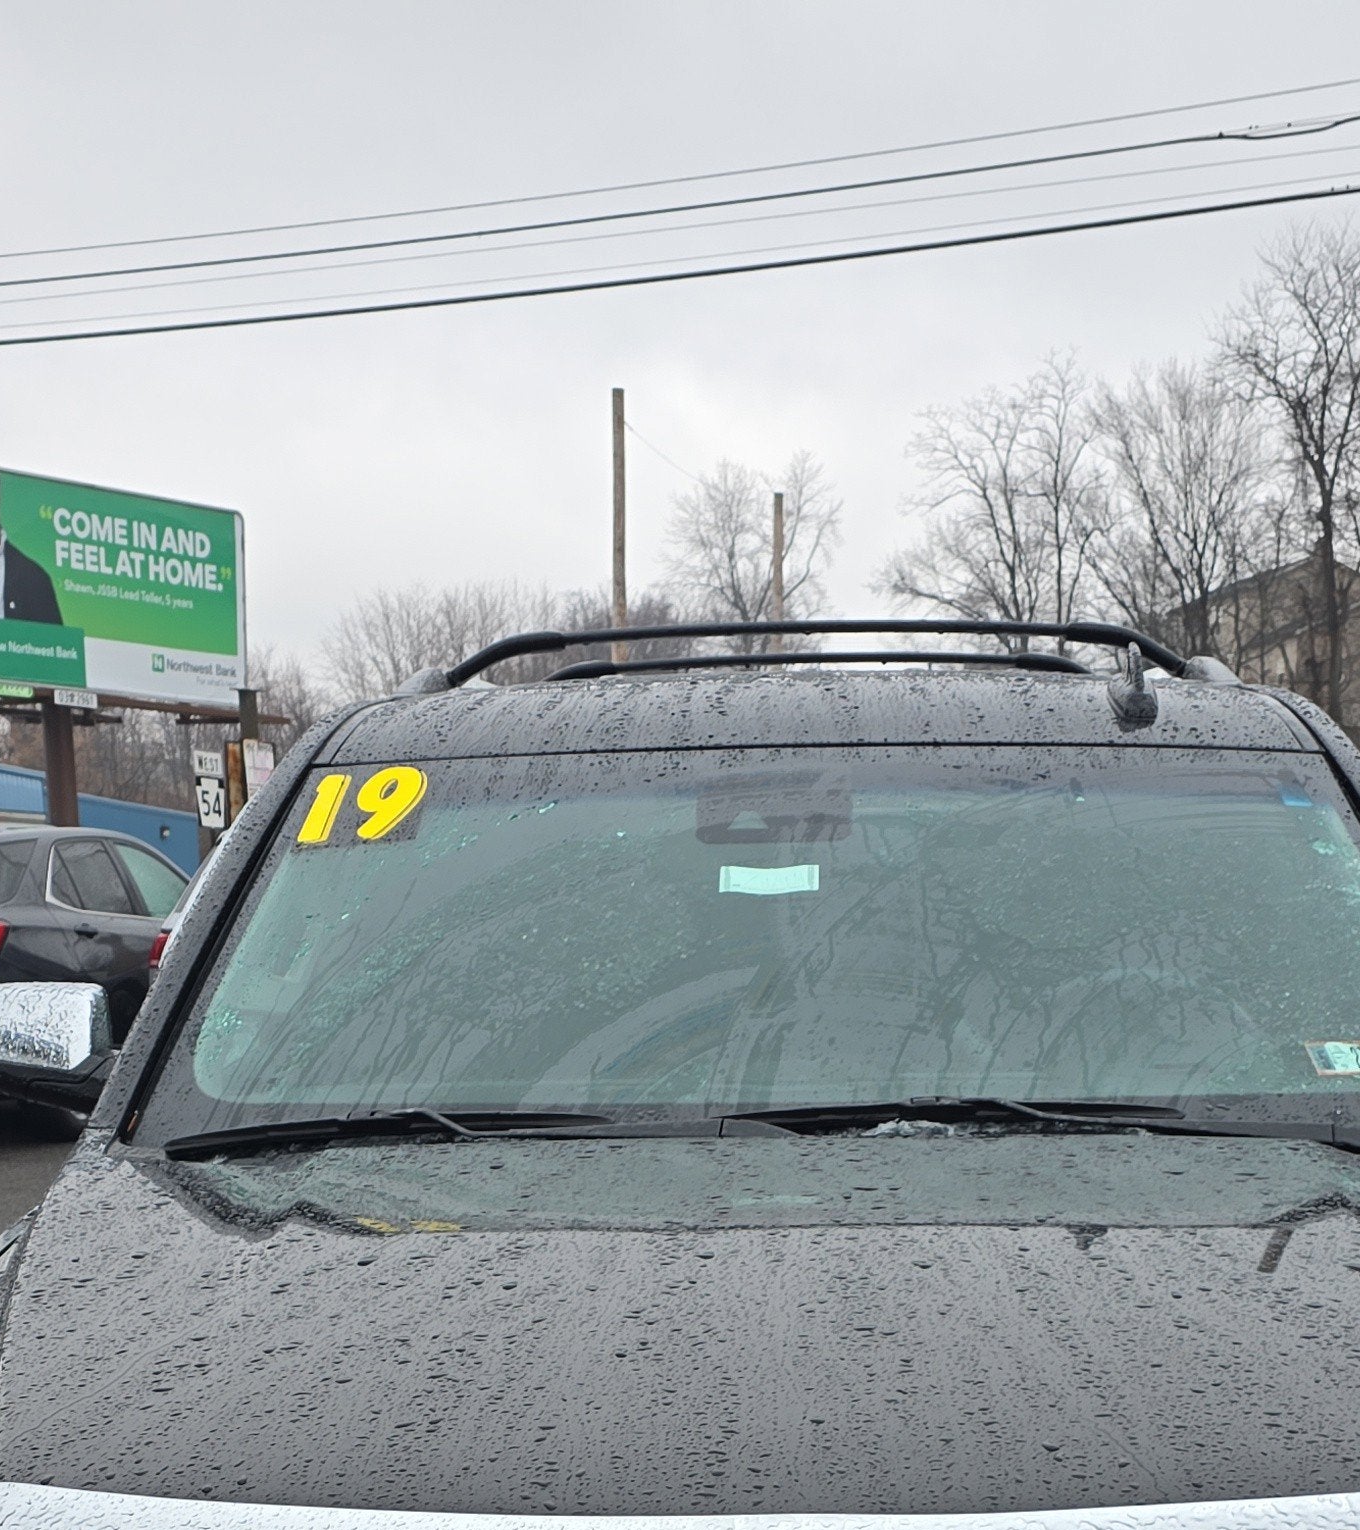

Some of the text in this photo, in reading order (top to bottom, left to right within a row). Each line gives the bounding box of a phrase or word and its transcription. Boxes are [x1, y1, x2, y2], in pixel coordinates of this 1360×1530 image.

[133, 520, 157, 551] IN
[160, 526, 211, 559] AND
[55, 540, 113, 575] FEEL
[115, 549, 144, 580] AT
[172, 598, 194, 610] years
[8, 640, 54, 658] Northwest
[55, 645, 78, 660] Bank
[166, 658, 237, 678] Northwest Bank
[196, 753, 220, 773] WEST
[201, 789, 222, 818] 54
[297, 765, 428, 844] 19
